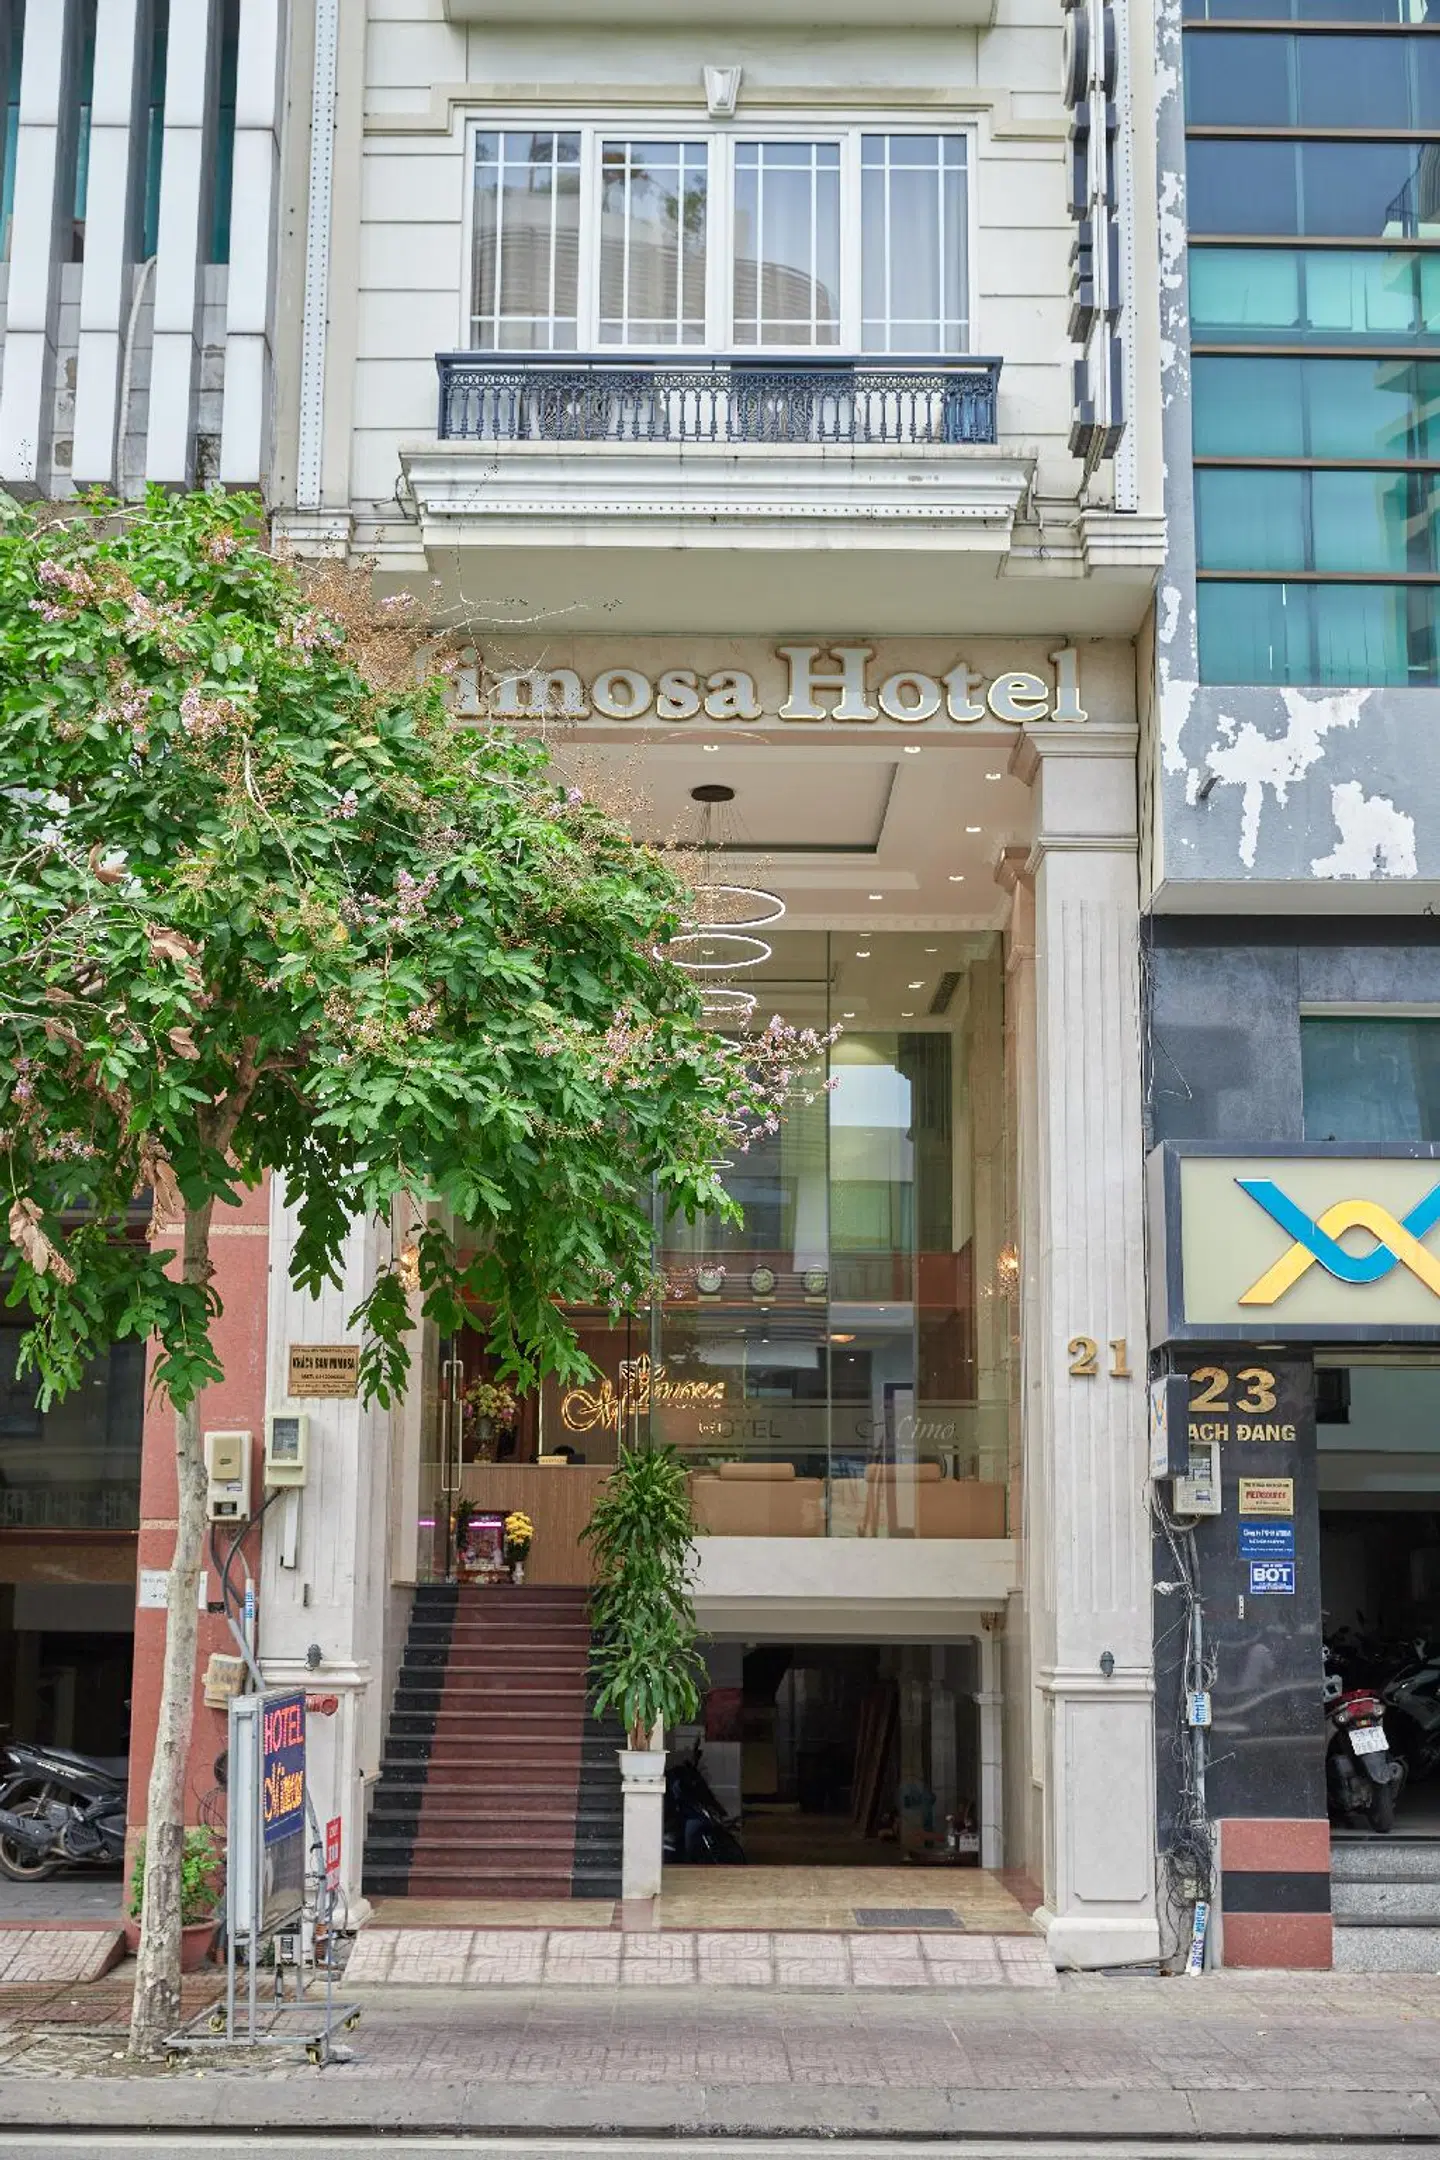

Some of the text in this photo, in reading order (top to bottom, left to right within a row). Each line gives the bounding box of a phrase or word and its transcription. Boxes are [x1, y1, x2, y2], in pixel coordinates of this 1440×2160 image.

[776, 645, 1089, 723] Hotel
[1068, 1336, 1131, 1378] 21
[1188, 1366, 1277, 1413] 23
[1188, 1424, 1229, 1442] ACH
[1253, 1567, 1291, 1582] BOT
[264, 1703, 304, 1755] HOTEL
